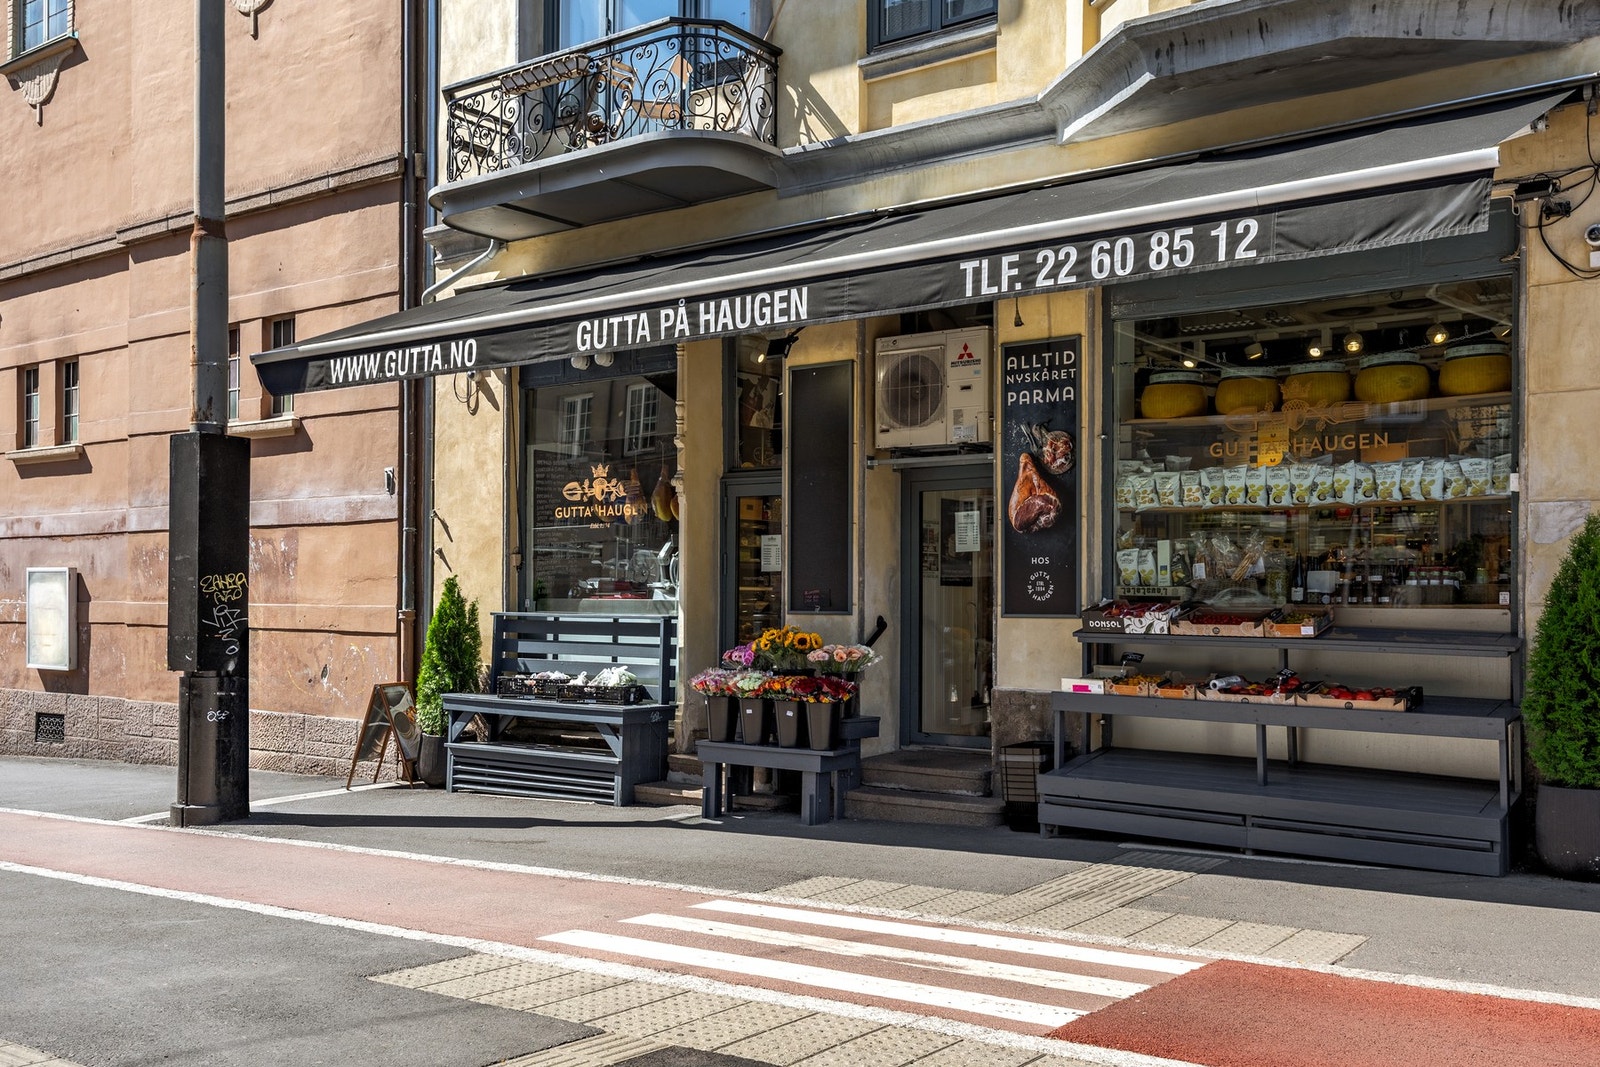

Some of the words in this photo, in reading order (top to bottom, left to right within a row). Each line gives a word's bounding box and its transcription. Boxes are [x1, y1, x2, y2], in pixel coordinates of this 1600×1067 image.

[959, 254, 1022, 297] TLF.
[1035, 246, 1078, 287] 22
[1091, 237, 1135, 280] 60
[1149, 227, 1194, 271] 85
[1210, 218, 1259, 262] 12
[576, 312, 651, 351] GUTTA
[660, 298, 690, 340] PÅ
[699, 286, 808, 334] HAUGEN
[330, 338, 477, 384] WWW.GUTTA.NO
[1007, 350, 1075, 371] ALLTID
[1006, 367, 1077, 385] NYSKÅRET
[1007, 386, 1074, 407] PARMA
[1209, 440, 1279, 458] GUTA
[1293, 432, 1389, 453] HAUGEN
[554, 505, 592, 519] GUTTA
[1031, 556, 1050, 565] HOS
[1029, 571, 1050, 581] GUTTA
[1032, 584, 1054, 602] HAUGEN
[1089, 620, 1122, 628] DONSOL
